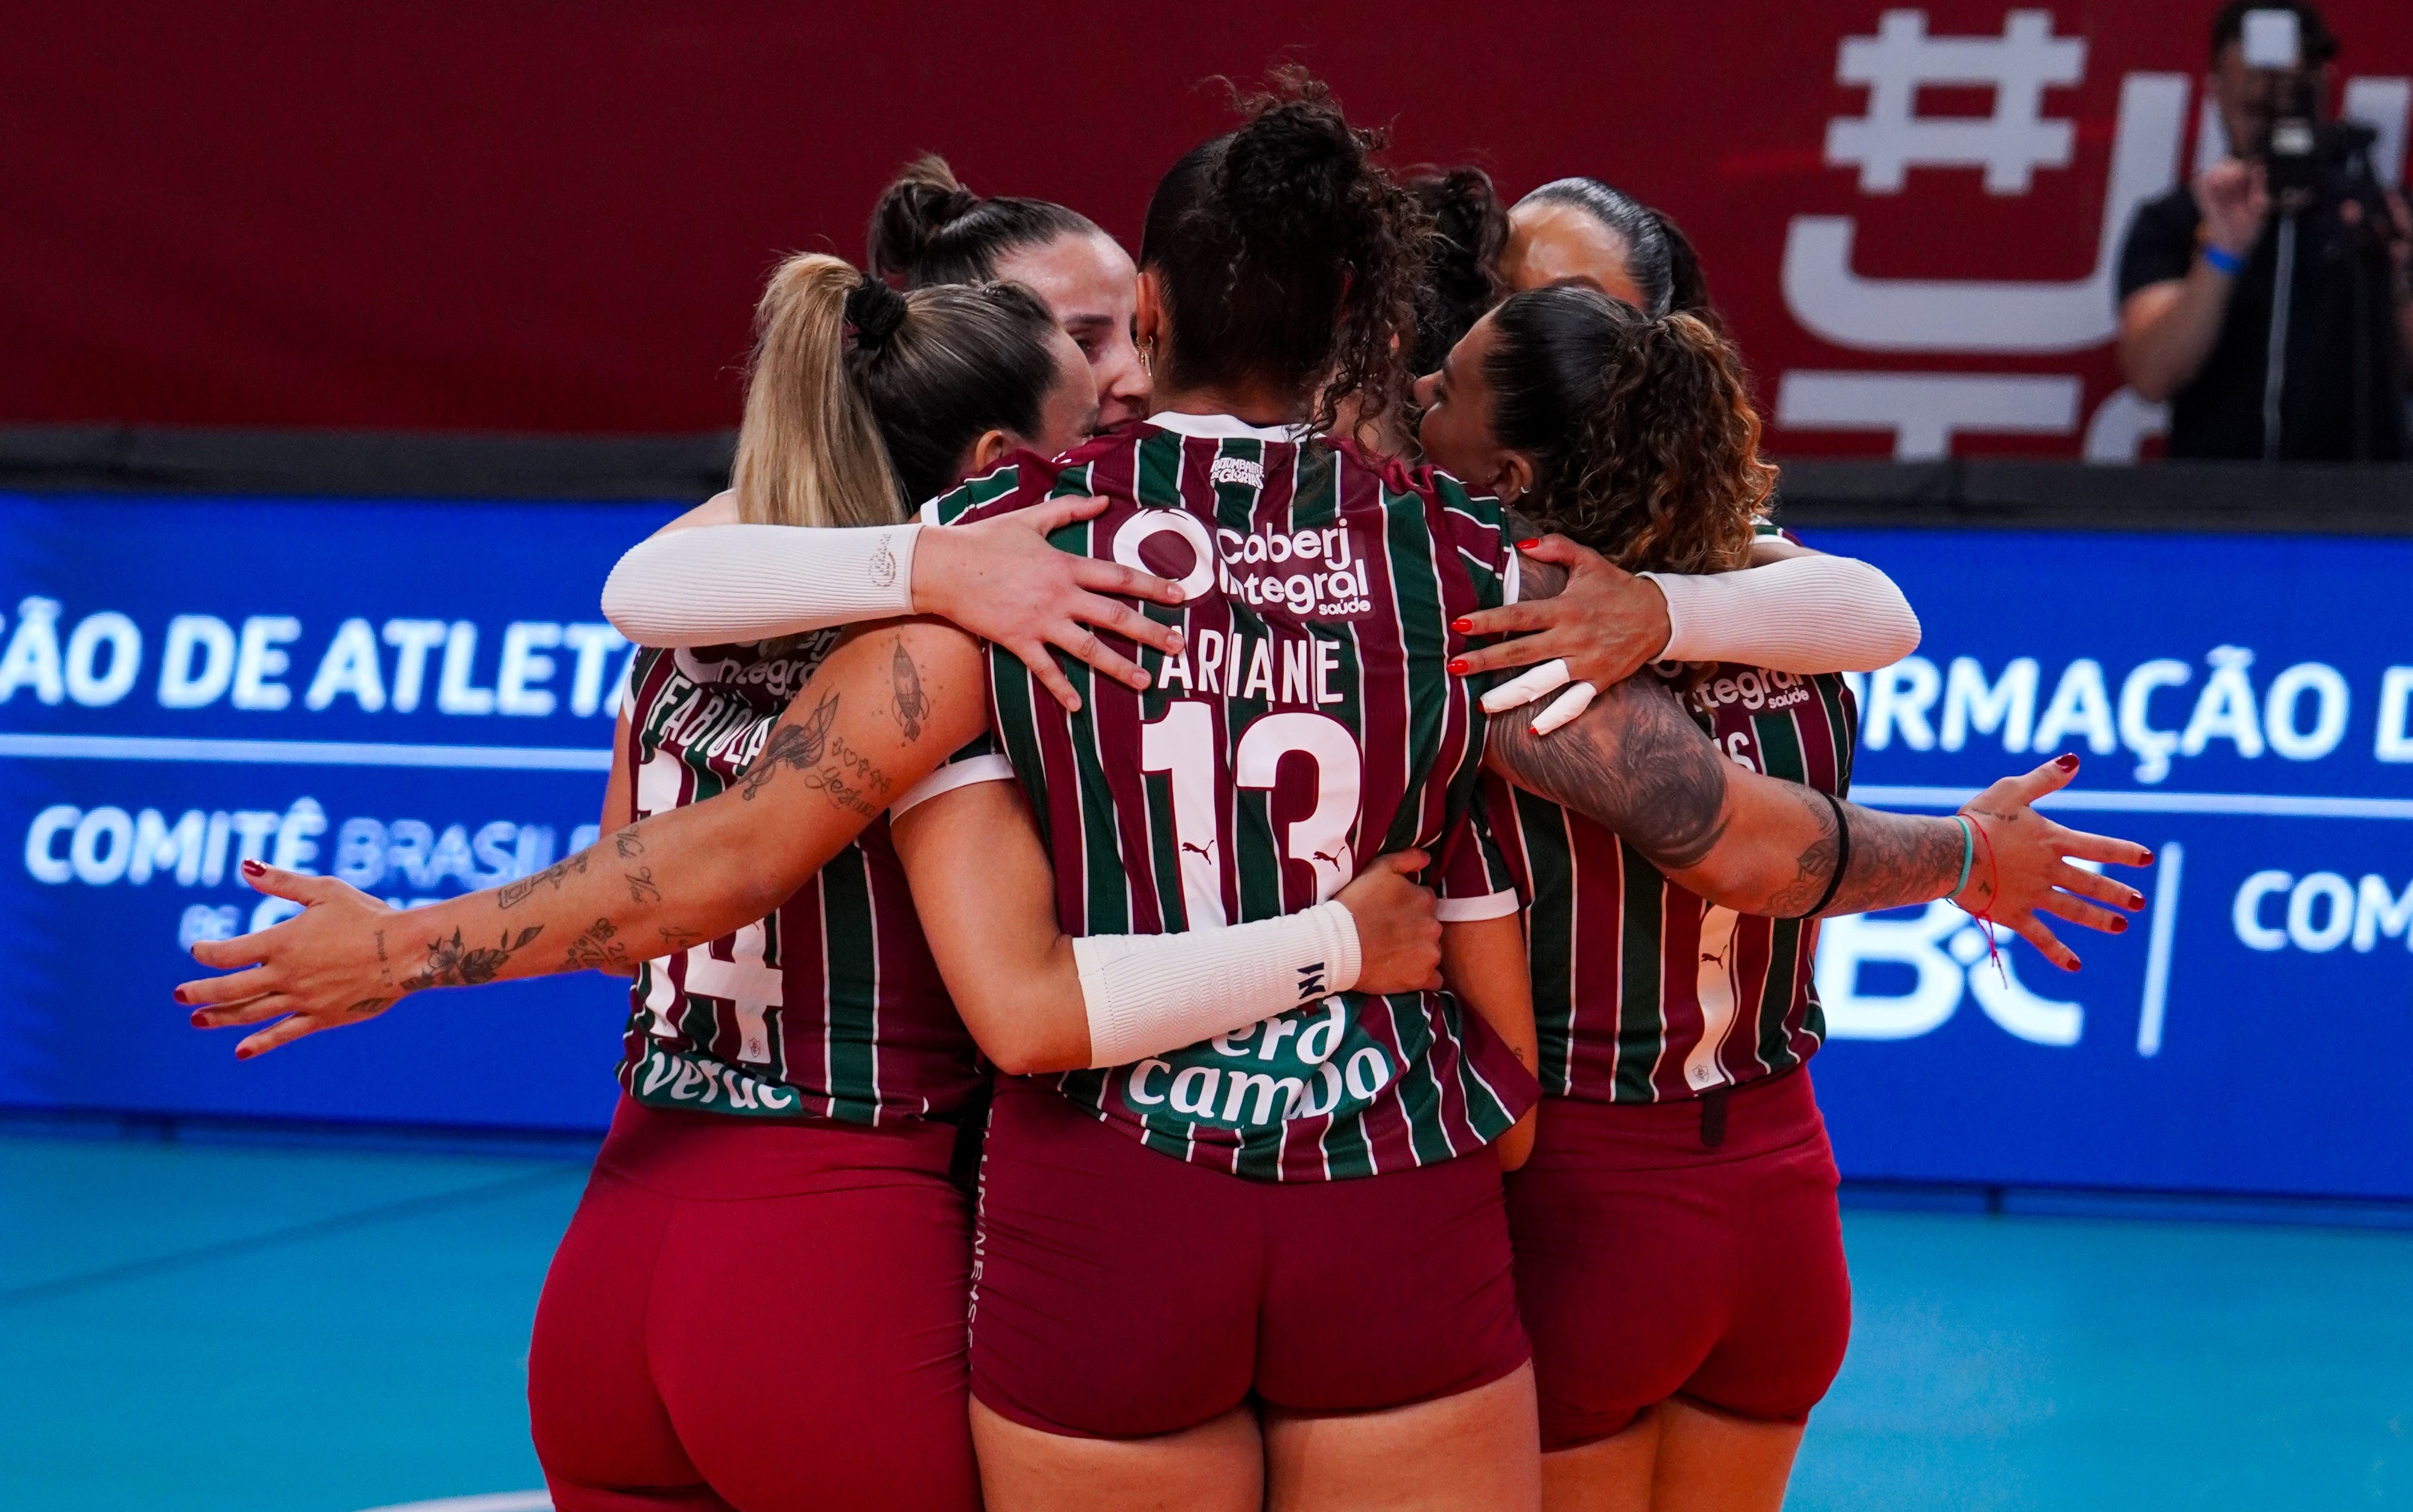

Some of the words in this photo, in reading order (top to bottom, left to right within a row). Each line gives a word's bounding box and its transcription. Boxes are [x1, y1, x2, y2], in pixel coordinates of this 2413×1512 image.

[1210, 457, 1264, 478] RETUMBANTE
[1216, 518, 1351, 571] Caberj
[1319, 597, 1371, 615] saúde
[0, 595, 143, 707] ÃO
[157, 613, 302, 711] DE
[1158, 625, 1344, 704] ARIANE
[1768, 687, 1809, 709] saúde
[1841, 644, 2351, 784] RMAÇÃO
[24, 796, 328, 888] COMITÊ
[332, 816, 601, 891] BRASIL
[1141, 701, 1361, 932] 13
[1211, 995, 1346, 1065] erd
